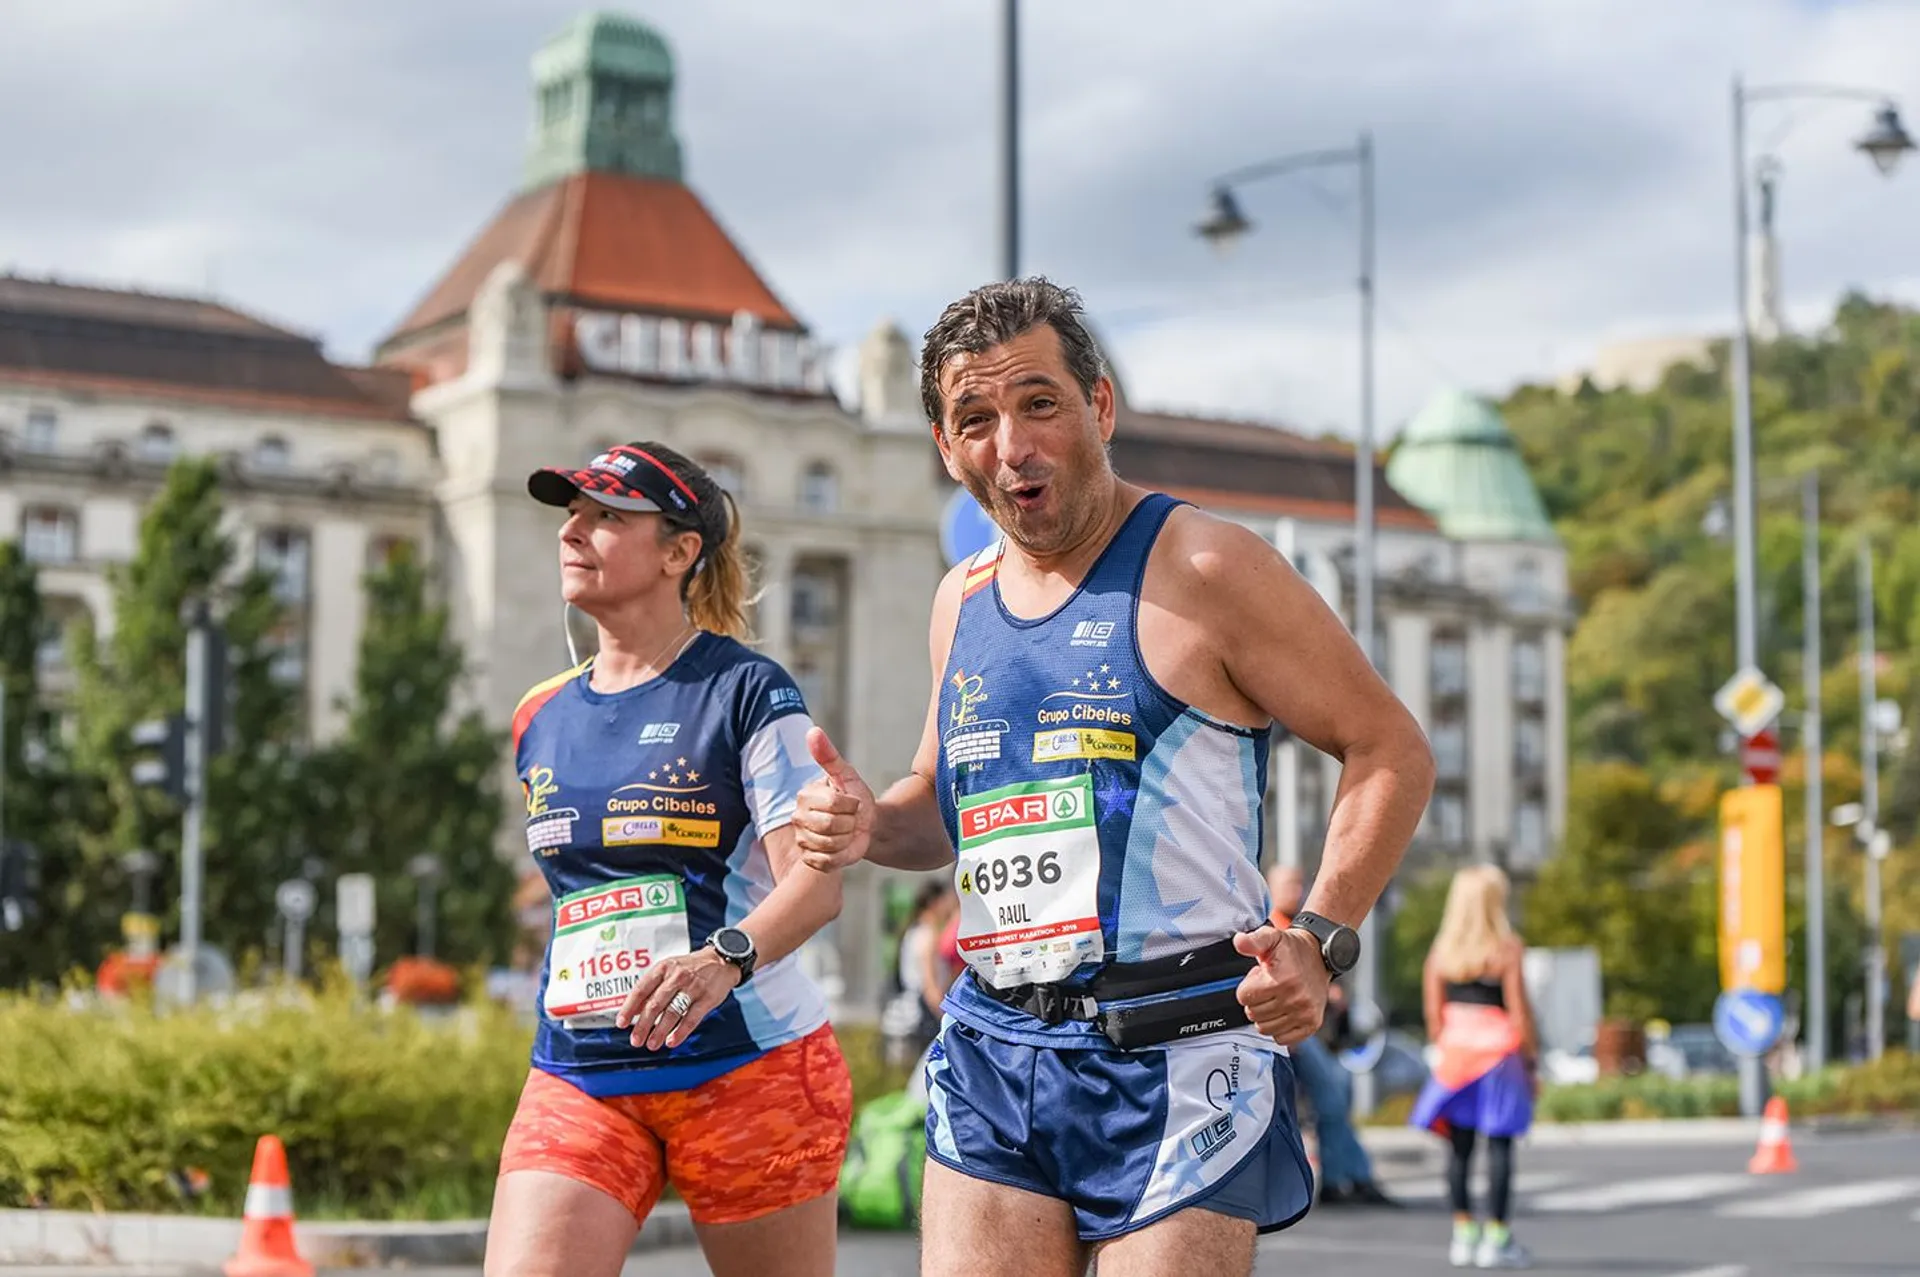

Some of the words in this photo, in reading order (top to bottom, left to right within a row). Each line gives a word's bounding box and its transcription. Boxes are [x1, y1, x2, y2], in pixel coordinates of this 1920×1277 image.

[1038, 709, 1069, 725] Grupo
[1072, 704, 1132, 726] Cibeles
[606, 797, 649, 813] Grupo
[652, 796, 716, 815] Cibeles
[973, 800, 1045, 831] SPAR
[962, 872, 971, 892] 4
[975, 851, 1062, 895] 6936
[568, 891, 641, 921] SPAR
[999, 903, 1031, 926] RAUL
[579, 948, 651, 979] 11665
[1180, 1019, 1224, 1034] FITLETIC
